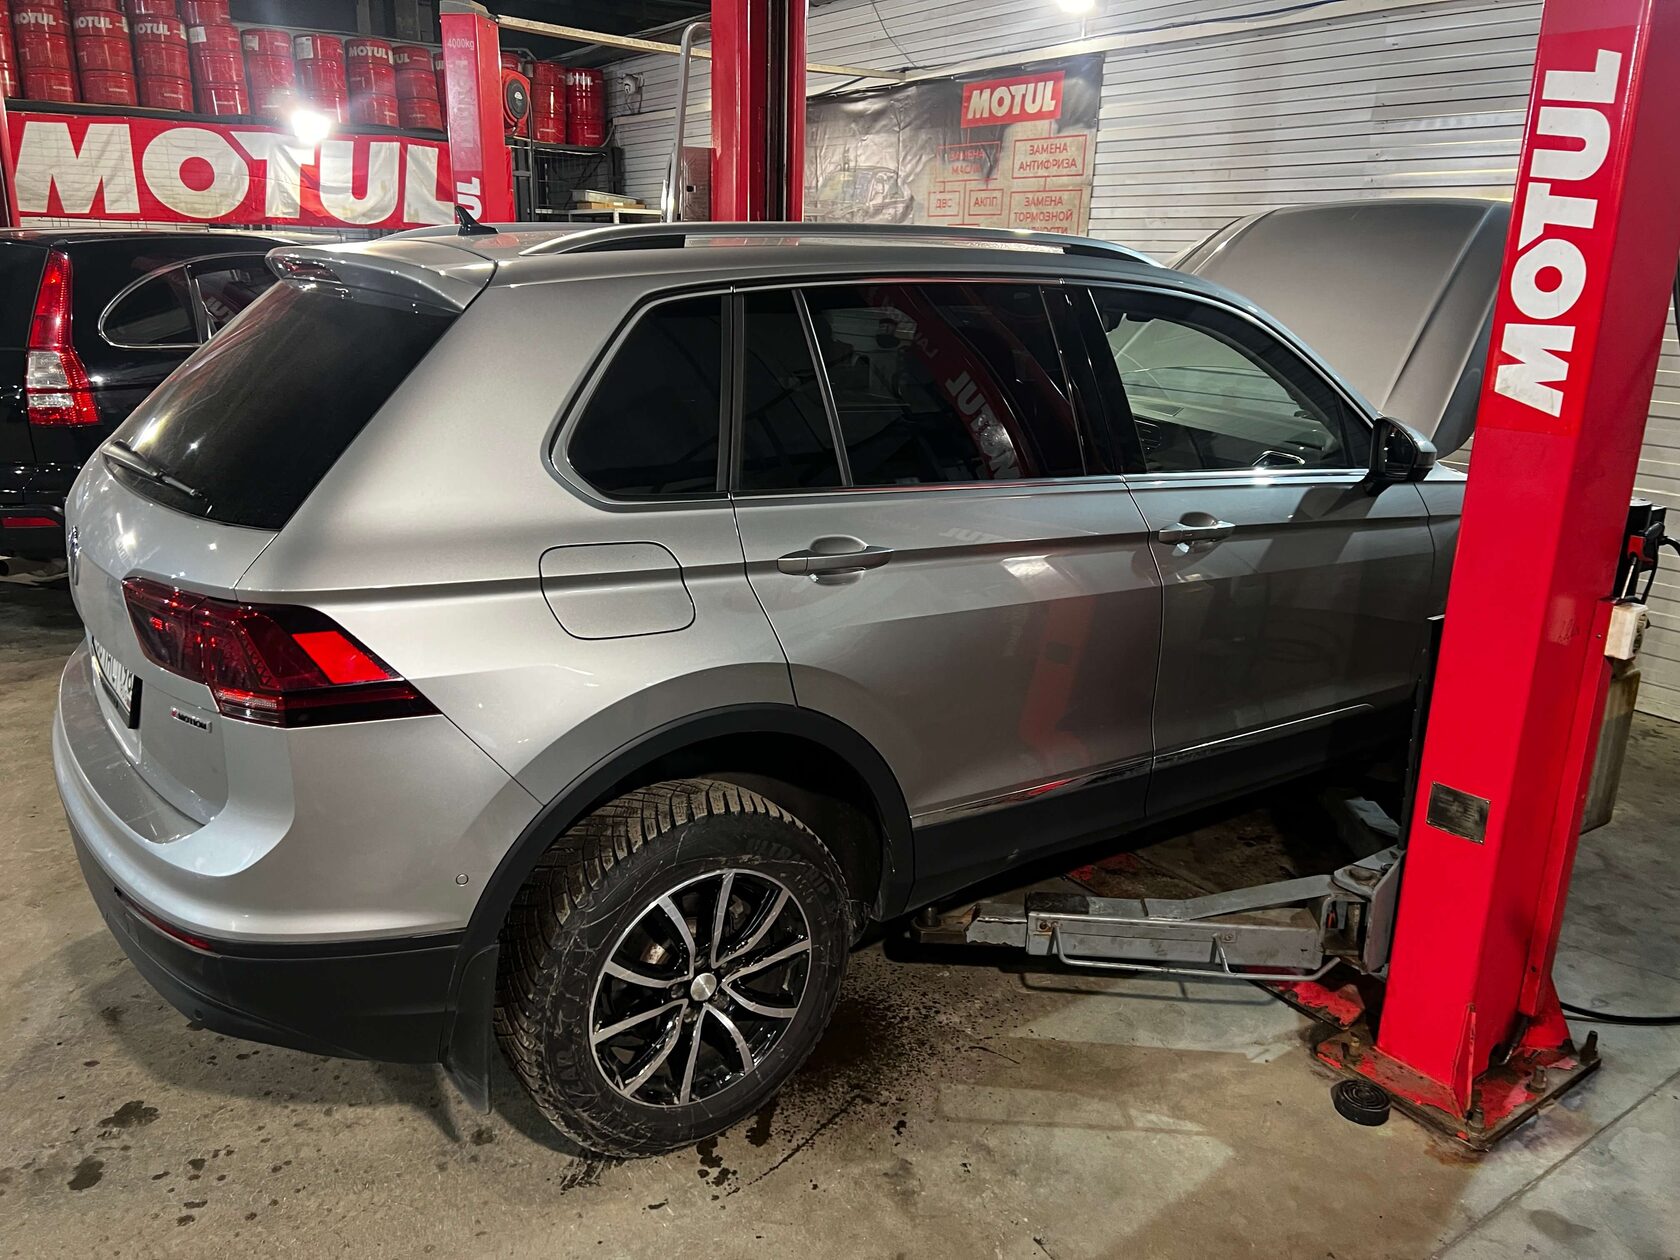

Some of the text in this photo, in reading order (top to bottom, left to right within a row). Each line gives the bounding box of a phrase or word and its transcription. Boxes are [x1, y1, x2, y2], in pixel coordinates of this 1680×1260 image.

[448, 39, 474, 50] 4000kg
[349, 46, 387, 58] MOTUL
[967, 81, 1056, 119] MOTUL
[1029, 143, 1068, 155] ЗАМЕНА
[1018, 158, 1077, 171] АНТИФРИЗА
[15, 121, 455, 225] MOTUL
[974, 196, 997, 207] АКПП
[1024, 196, 1063, 207] ЗАМЕНА
[1014, 209, 1073, 222] ТОРМОЗНОЙ
[1494, 48, 1622, 418] MOTUL
